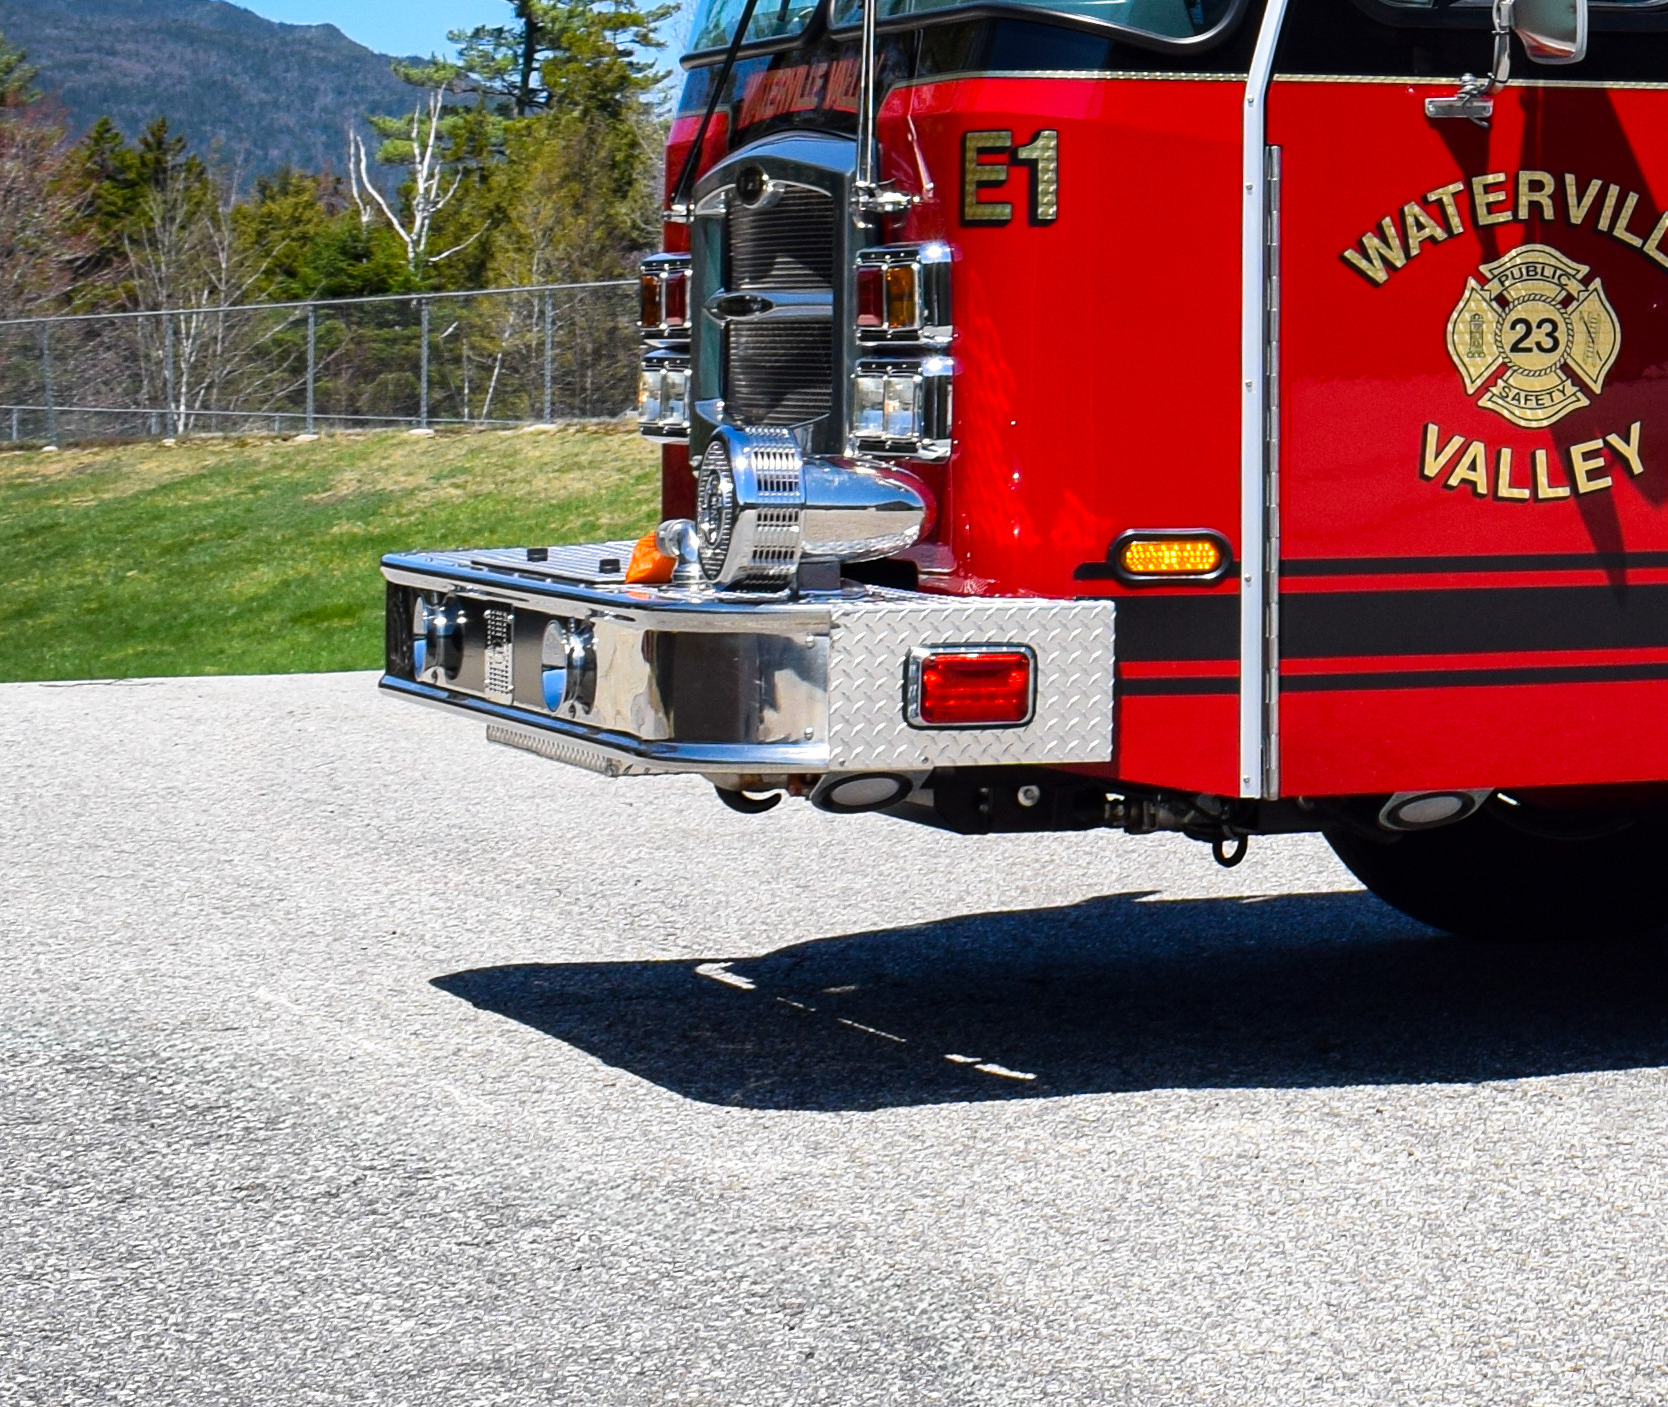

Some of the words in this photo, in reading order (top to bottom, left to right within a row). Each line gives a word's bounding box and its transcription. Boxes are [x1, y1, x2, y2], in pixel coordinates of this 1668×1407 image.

[961, 129, 1060, 228] E1
[1497, 264, 1572, 289] PUBLIC
[1509, 317, 1560, 354] 23
[1498, 383, 1568, 407] SAFETY
[1420, 421, 1644, 502] VALLEY
